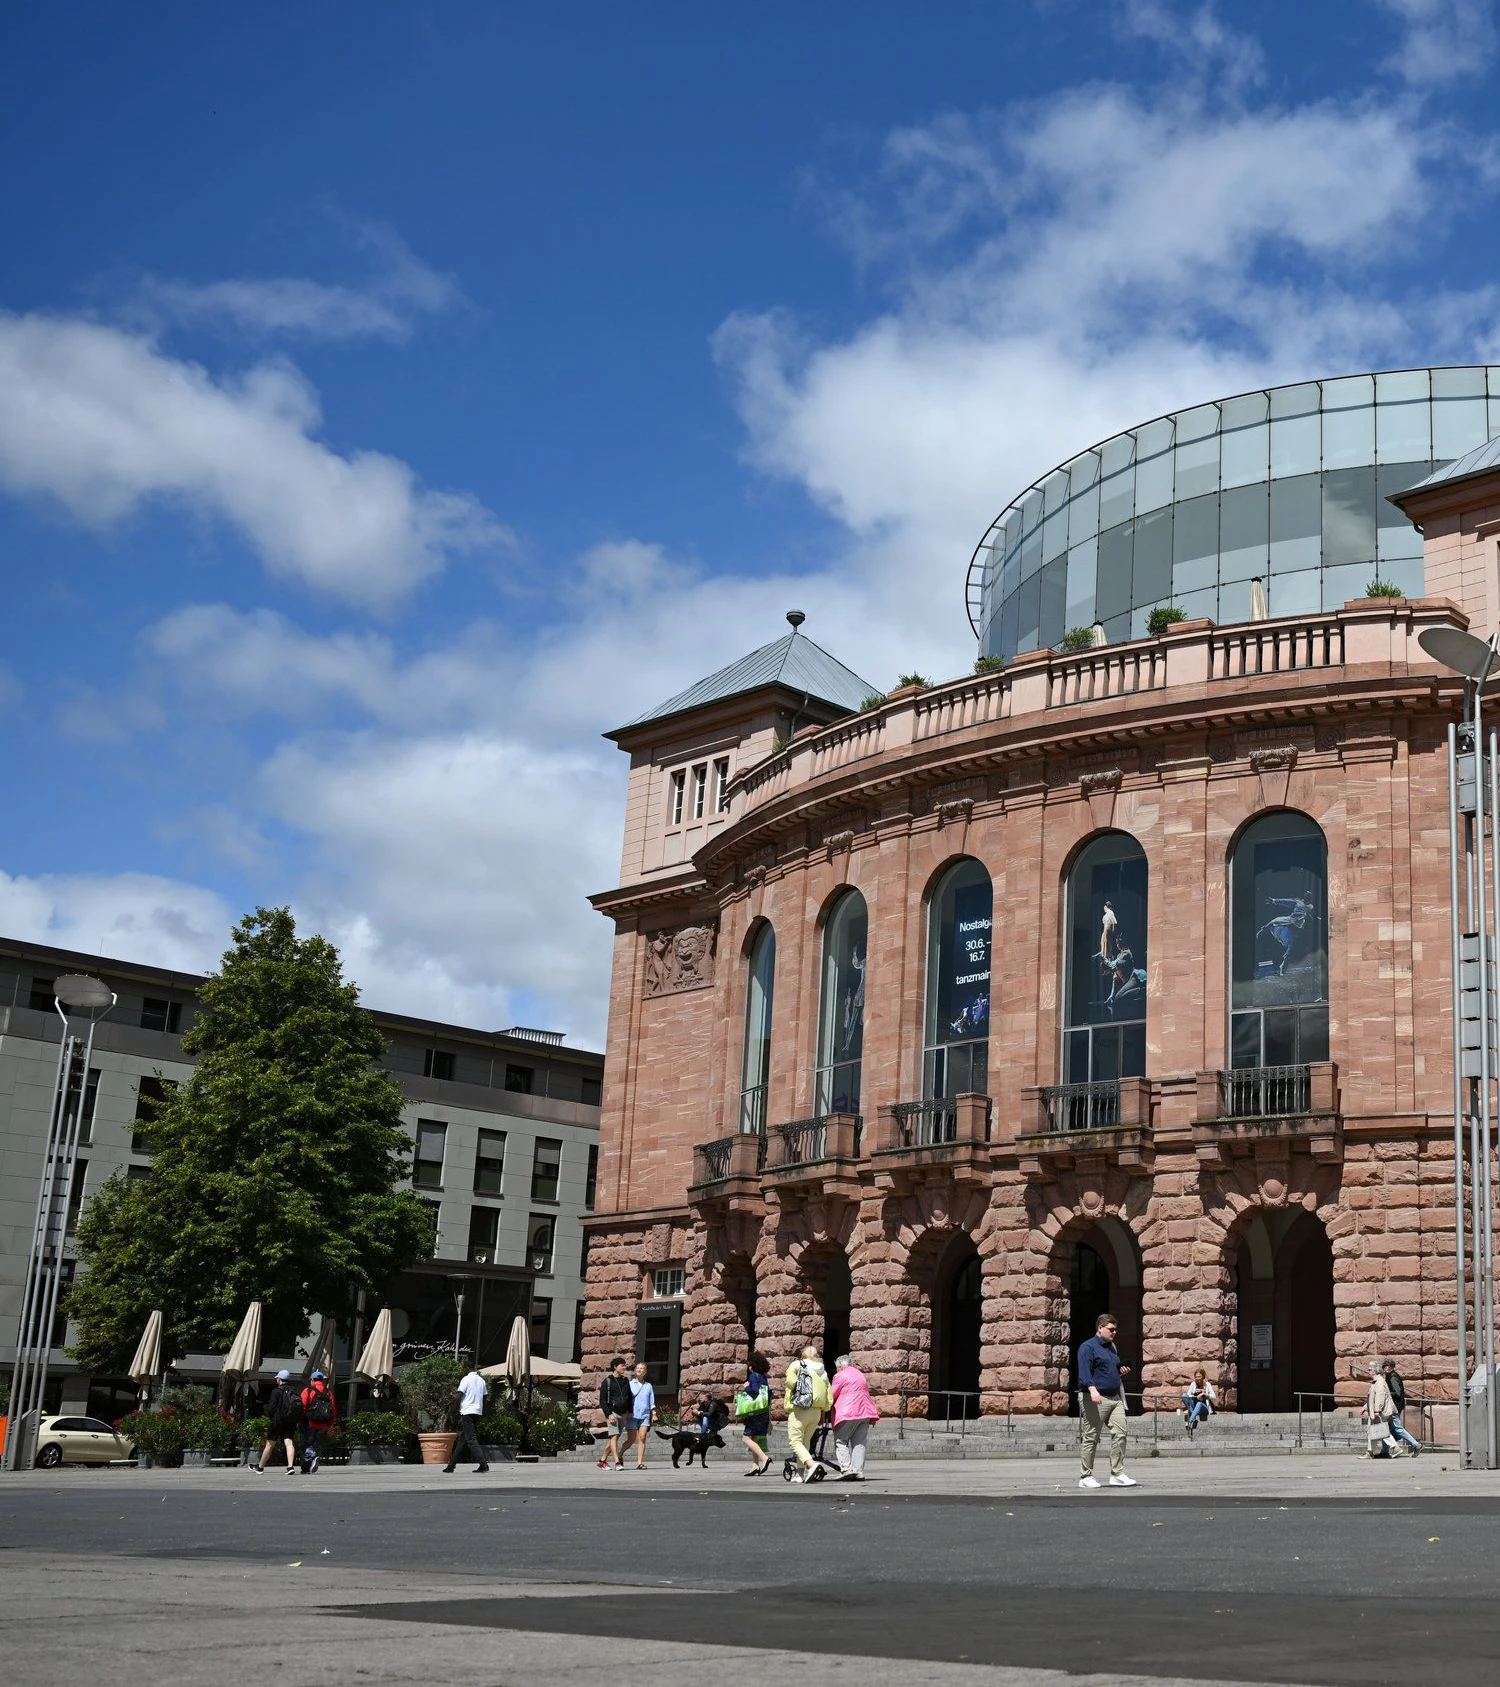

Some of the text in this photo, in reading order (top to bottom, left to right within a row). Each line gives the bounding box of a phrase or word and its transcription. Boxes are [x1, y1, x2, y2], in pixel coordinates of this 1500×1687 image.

[965, 939, 985, 950] 30.6.
[969, 951, 985, 962] 16.7.
[956, 970, 991, 984] tanzmain
